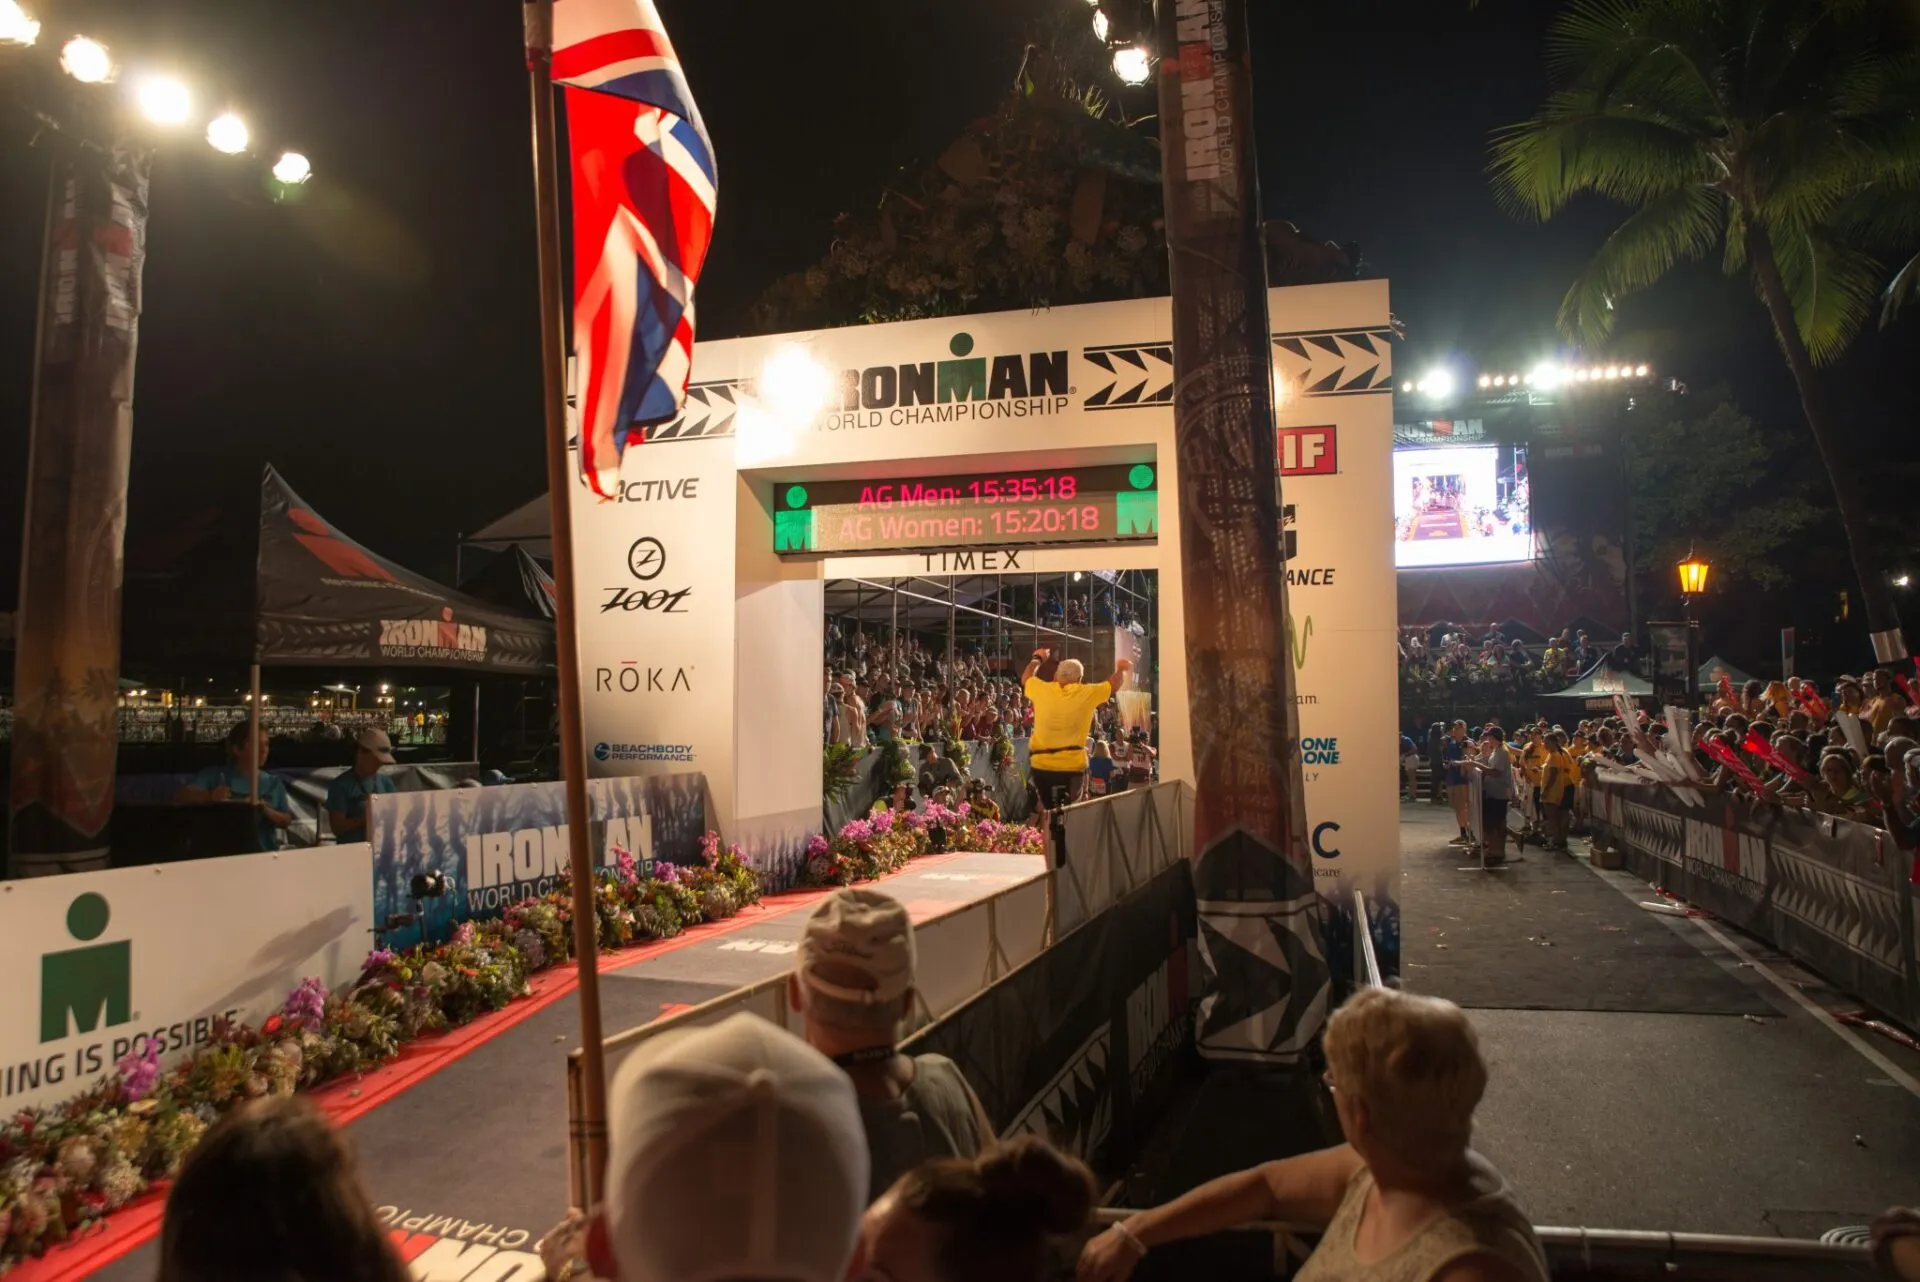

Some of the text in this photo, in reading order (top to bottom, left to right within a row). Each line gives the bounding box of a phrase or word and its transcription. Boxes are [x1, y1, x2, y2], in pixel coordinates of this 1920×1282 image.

[828, 332, 1069, 411] RONMAN
[890, 397, 1069, 426] CHAMPIONSHIP
[859, 475, 1077, 511] AG Men: 15:35:18
[839, 506, 1099, 542] AG Women: 15:20:18
[920, 550, 1021, 573] TIMEX
[379, 607, 487, 652] IRONMAN
[381, 646, 486, 662] WORLD CHAMPIONSHIP
[612, 743, 693, 754] BEACHBODY
[612, 753, 694, 763] PERFORMANCE
[1301, 751, 1341, 765] ONE
[466, 814, 653, 890] IRONAN
[76, 1043, 104, 1076] IS
